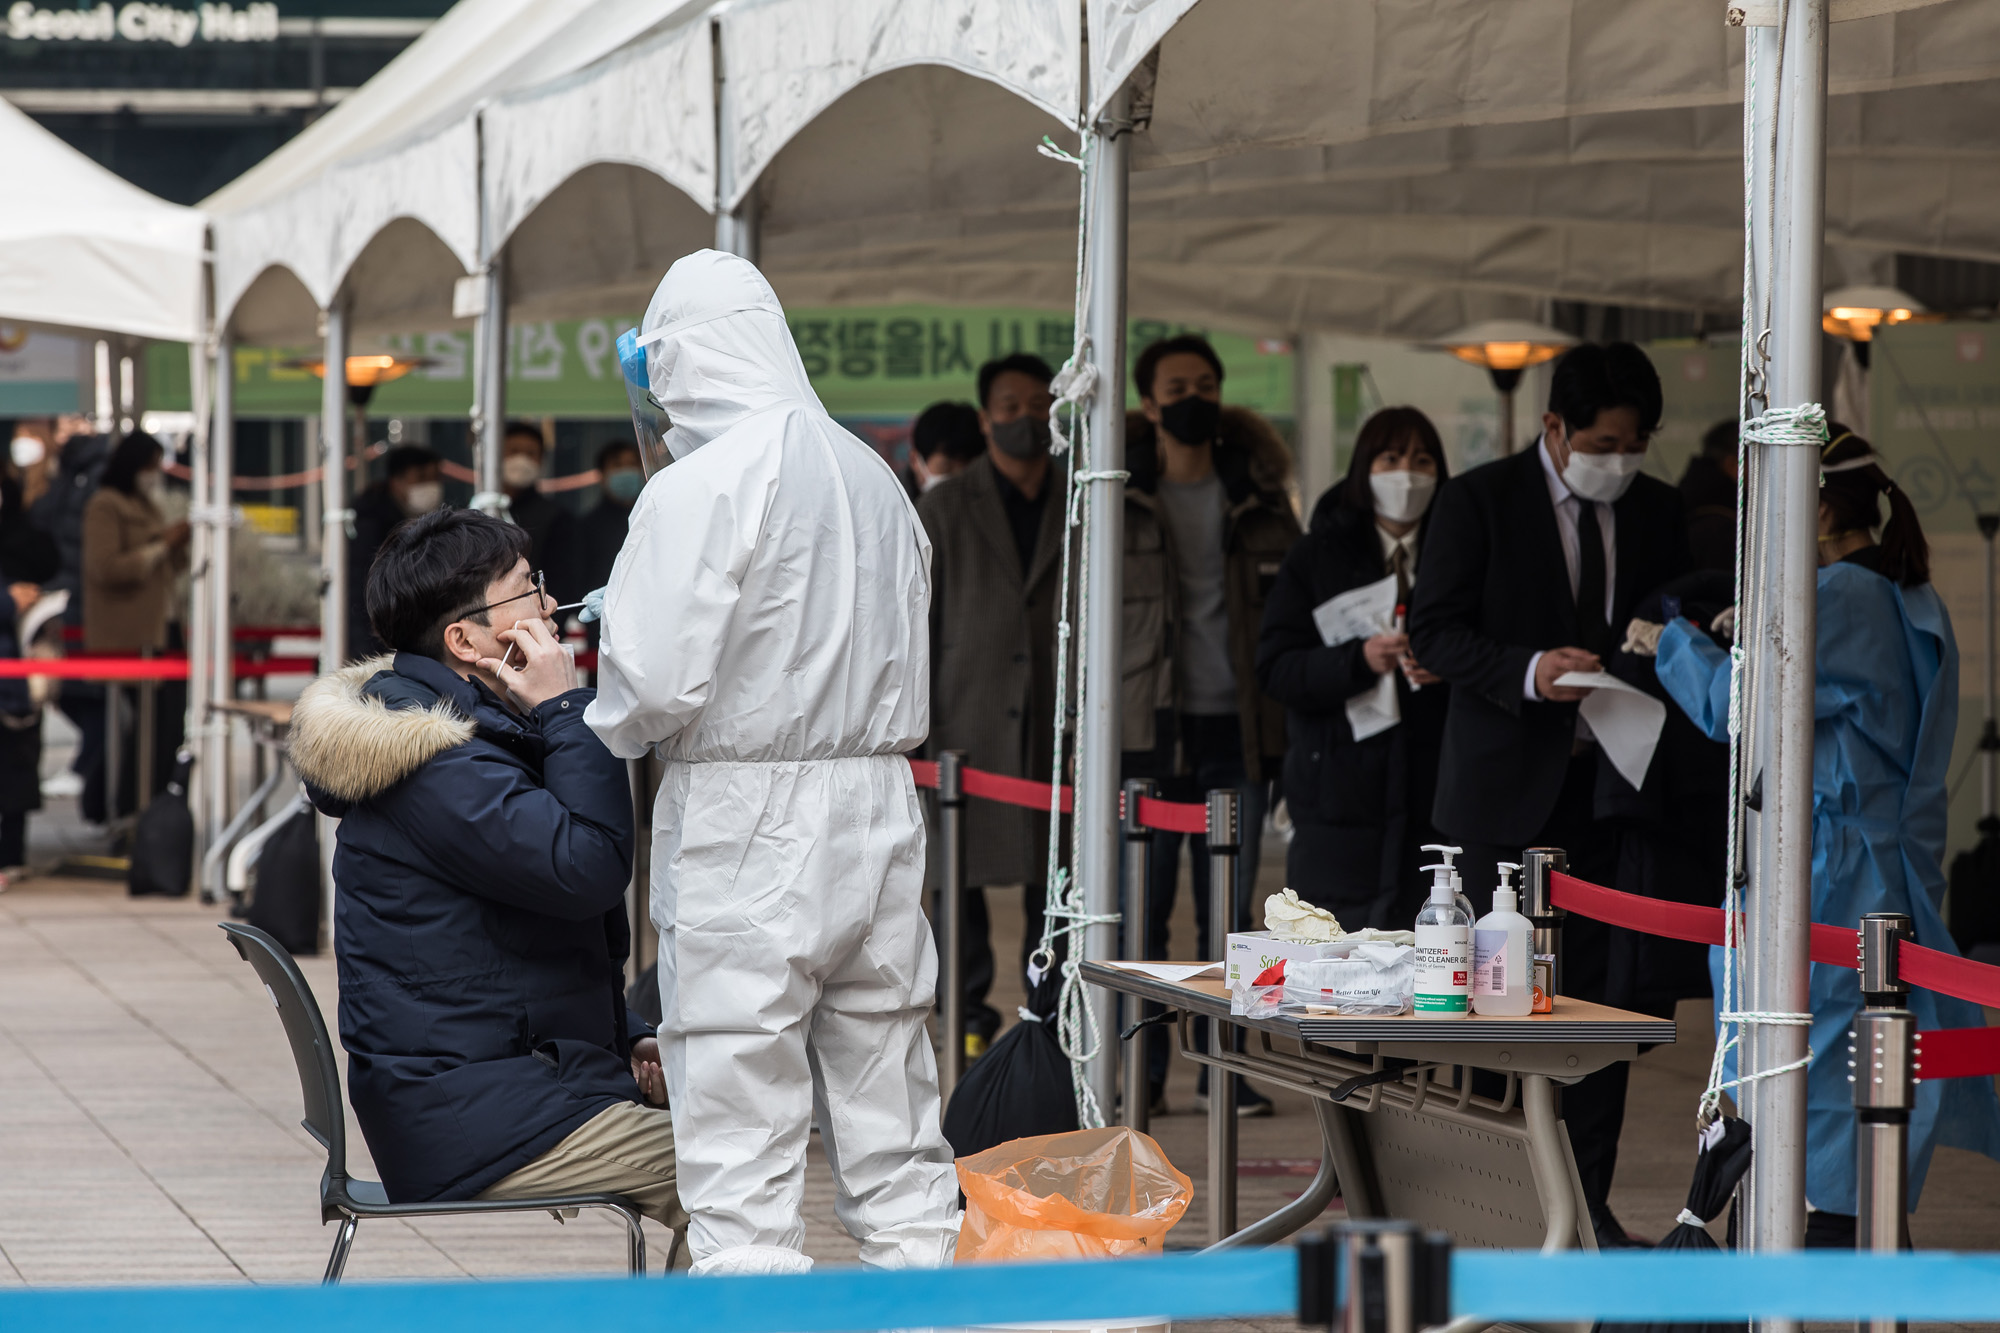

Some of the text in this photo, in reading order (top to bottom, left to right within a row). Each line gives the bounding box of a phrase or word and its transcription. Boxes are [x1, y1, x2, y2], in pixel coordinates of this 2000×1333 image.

[7, 0, 279, 48] Seoul City Hall
[1260, 955, 1280, 969] Saf
[1427, 956, 1459, 964] CLEANER
[1371, 988, 1381, 996] Life
